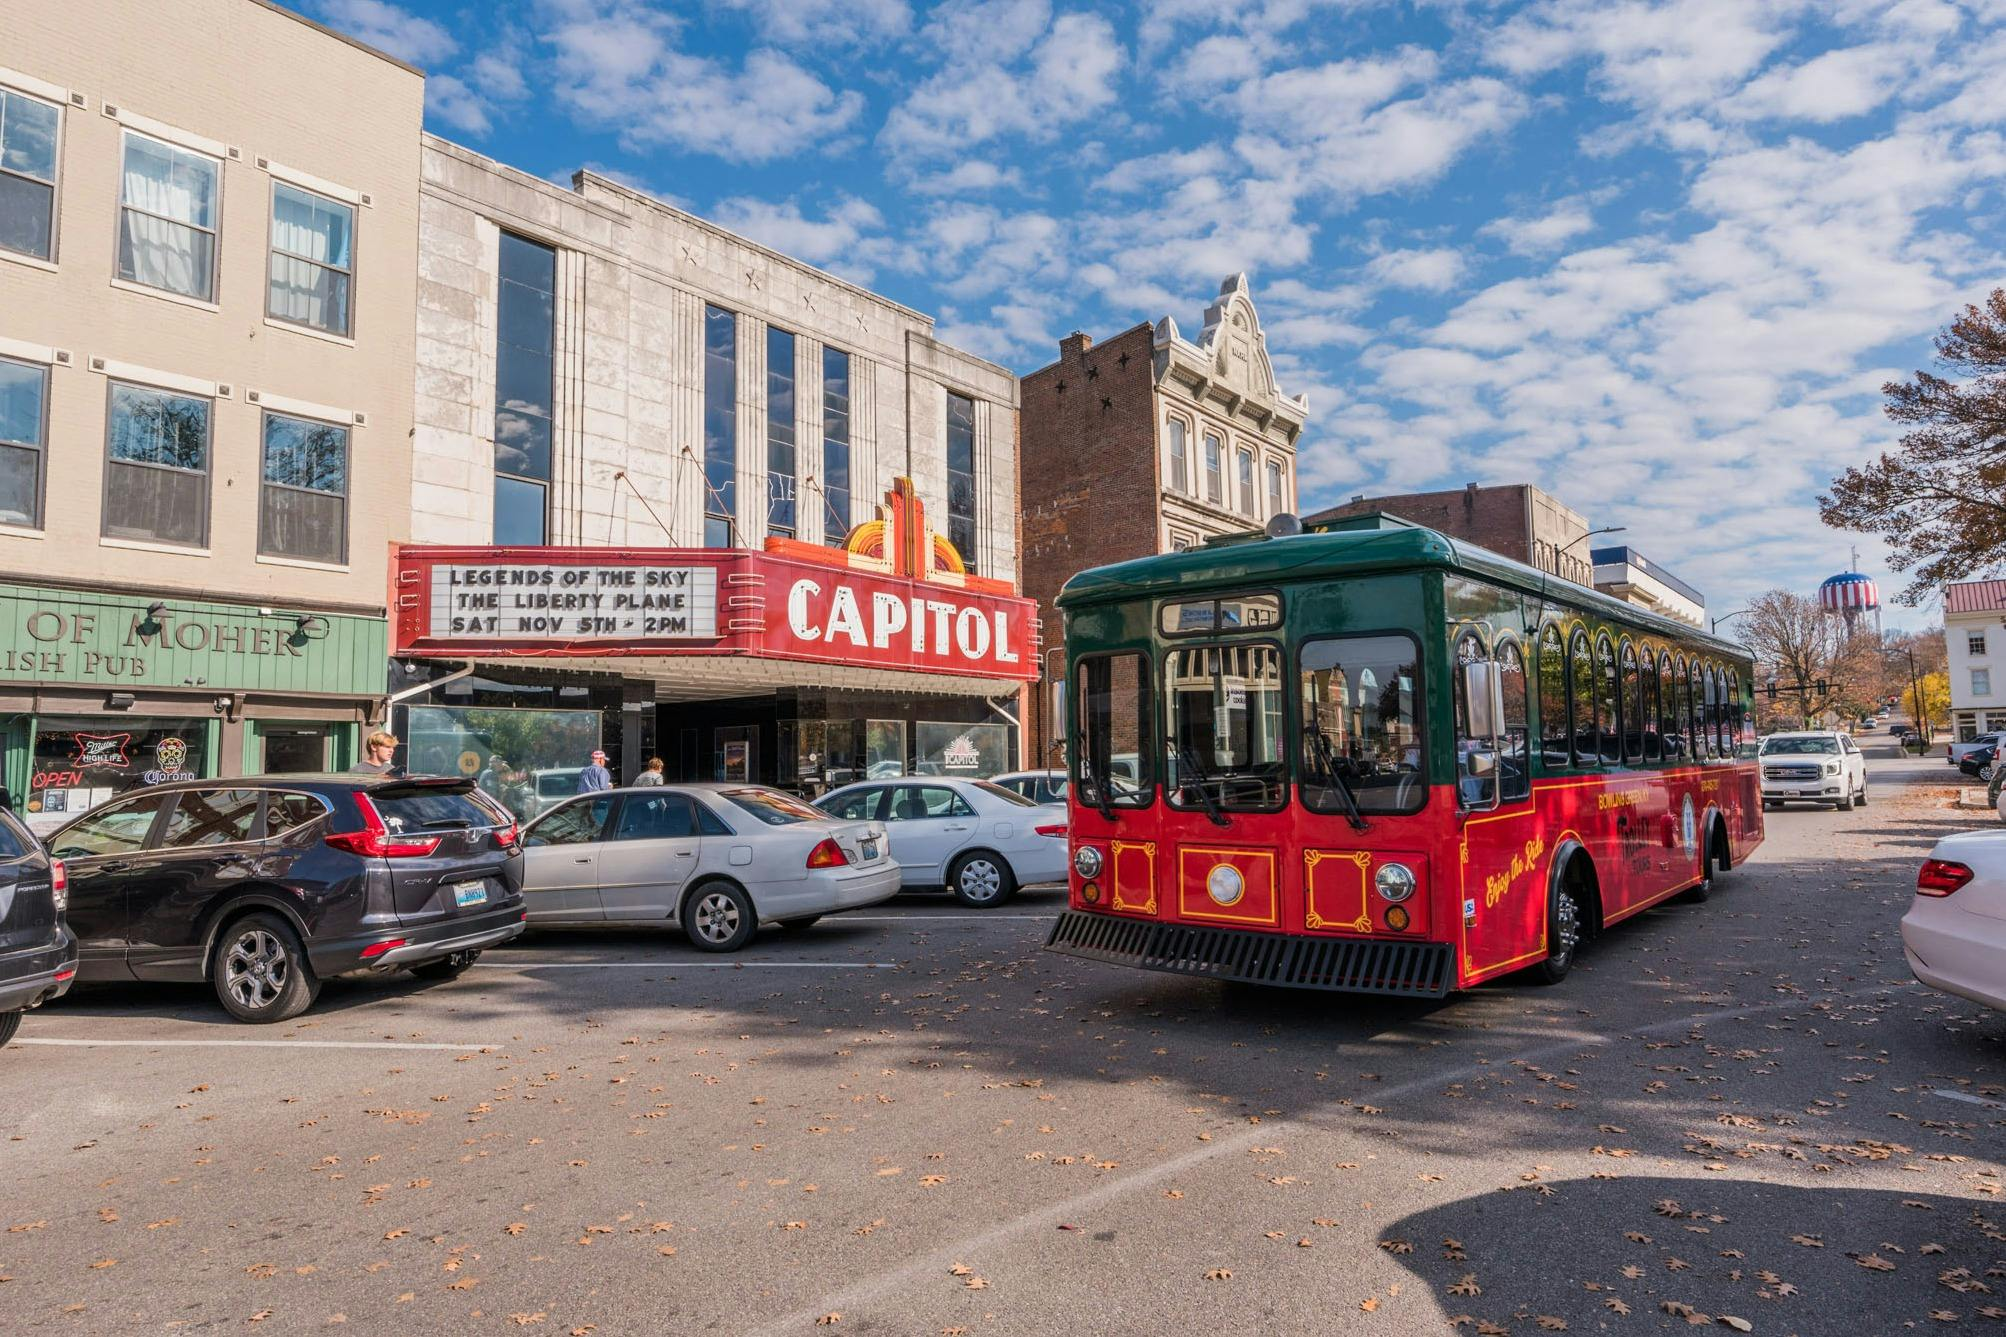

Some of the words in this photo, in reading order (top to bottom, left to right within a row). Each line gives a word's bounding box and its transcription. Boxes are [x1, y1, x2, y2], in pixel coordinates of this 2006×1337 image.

[450, 569, 554, 587] LEGENDS
[563, 570, 590, 585] OF
[597, 571, 636, 585] THE
[646, 571, 688, 586] SKY
[458, 593, 498, 609] THE
[514, 593, 603, 609] LIBERTY
[615, 594, 685, 609] PLANE
[452, 616, 498, 632] SAT
[519, 616, 563, 632] NOV
[579, 617, 617, 632] 5TH
[645, 617, 686, 632] 2PM
[787, 578, 1019, 663] CAPITOL
[27, 610, 96, 643] OF
[123, 611, 303, 657] MOHER
[0, 650, 67, 673] ISH
[84, 652, 145, 677] PUB
[86, 740, 118, 754] Miller
[83, 754, 102, 762] HIGH
[104, 754, 122, 762] LIFE
[32, 771, 83, 788] OPEN
[144, 769, 195, 785] Corona
[1486, 871, 1510, 908] Enjoy
[1511, 853, 1524, 881] the
[1525, 834, 1544, 871] Ride
